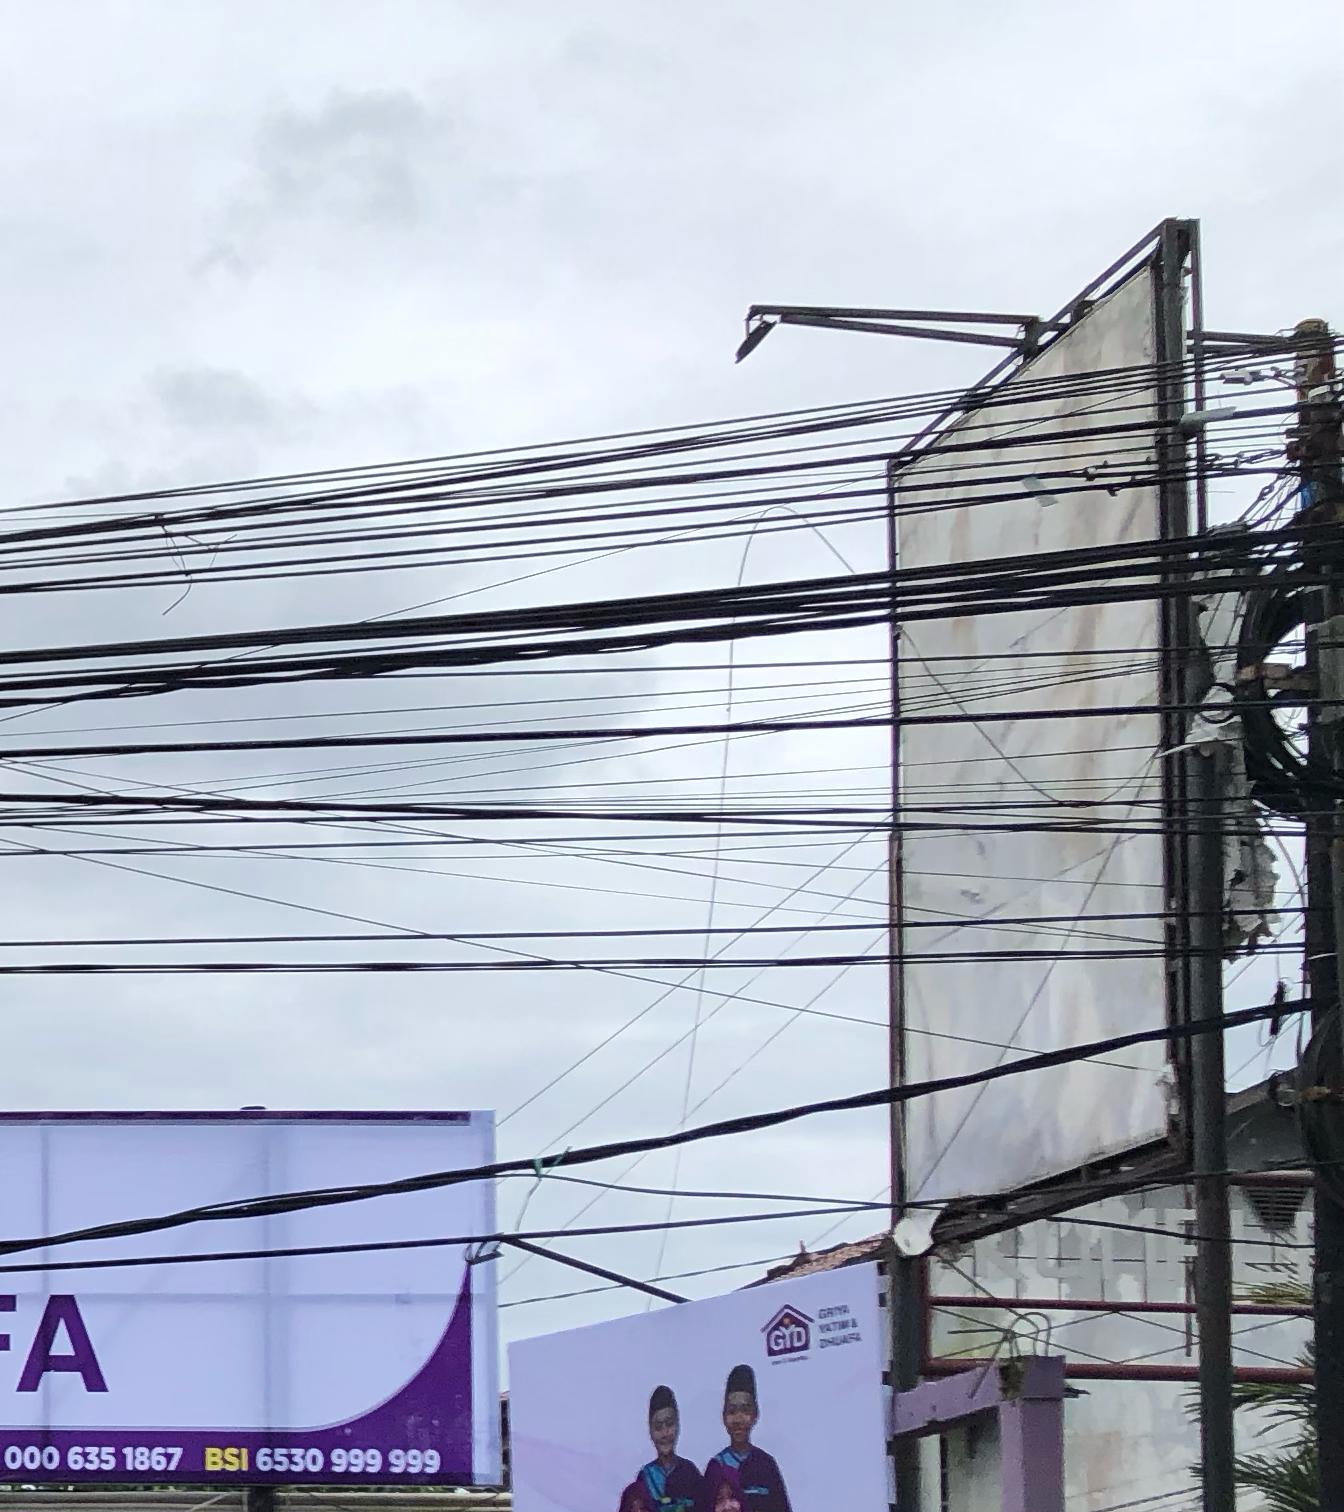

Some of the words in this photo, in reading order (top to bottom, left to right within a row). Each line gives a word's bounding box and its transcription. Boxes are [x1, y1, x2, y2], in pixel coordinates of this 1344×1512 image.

[769, 1324, 807, 1351] GYD
[4, 1446, 60, 1470] 000
[66, 1446, 116, 1470] 635
[121, 1446, 184, 1471] 1867
[204, 1447, 249, 1472] BSI
[255, 1448, 324, 1472] 6530
[330, 1448, 384, 1473] 999
[388, 1449, 441, 1474] 999
